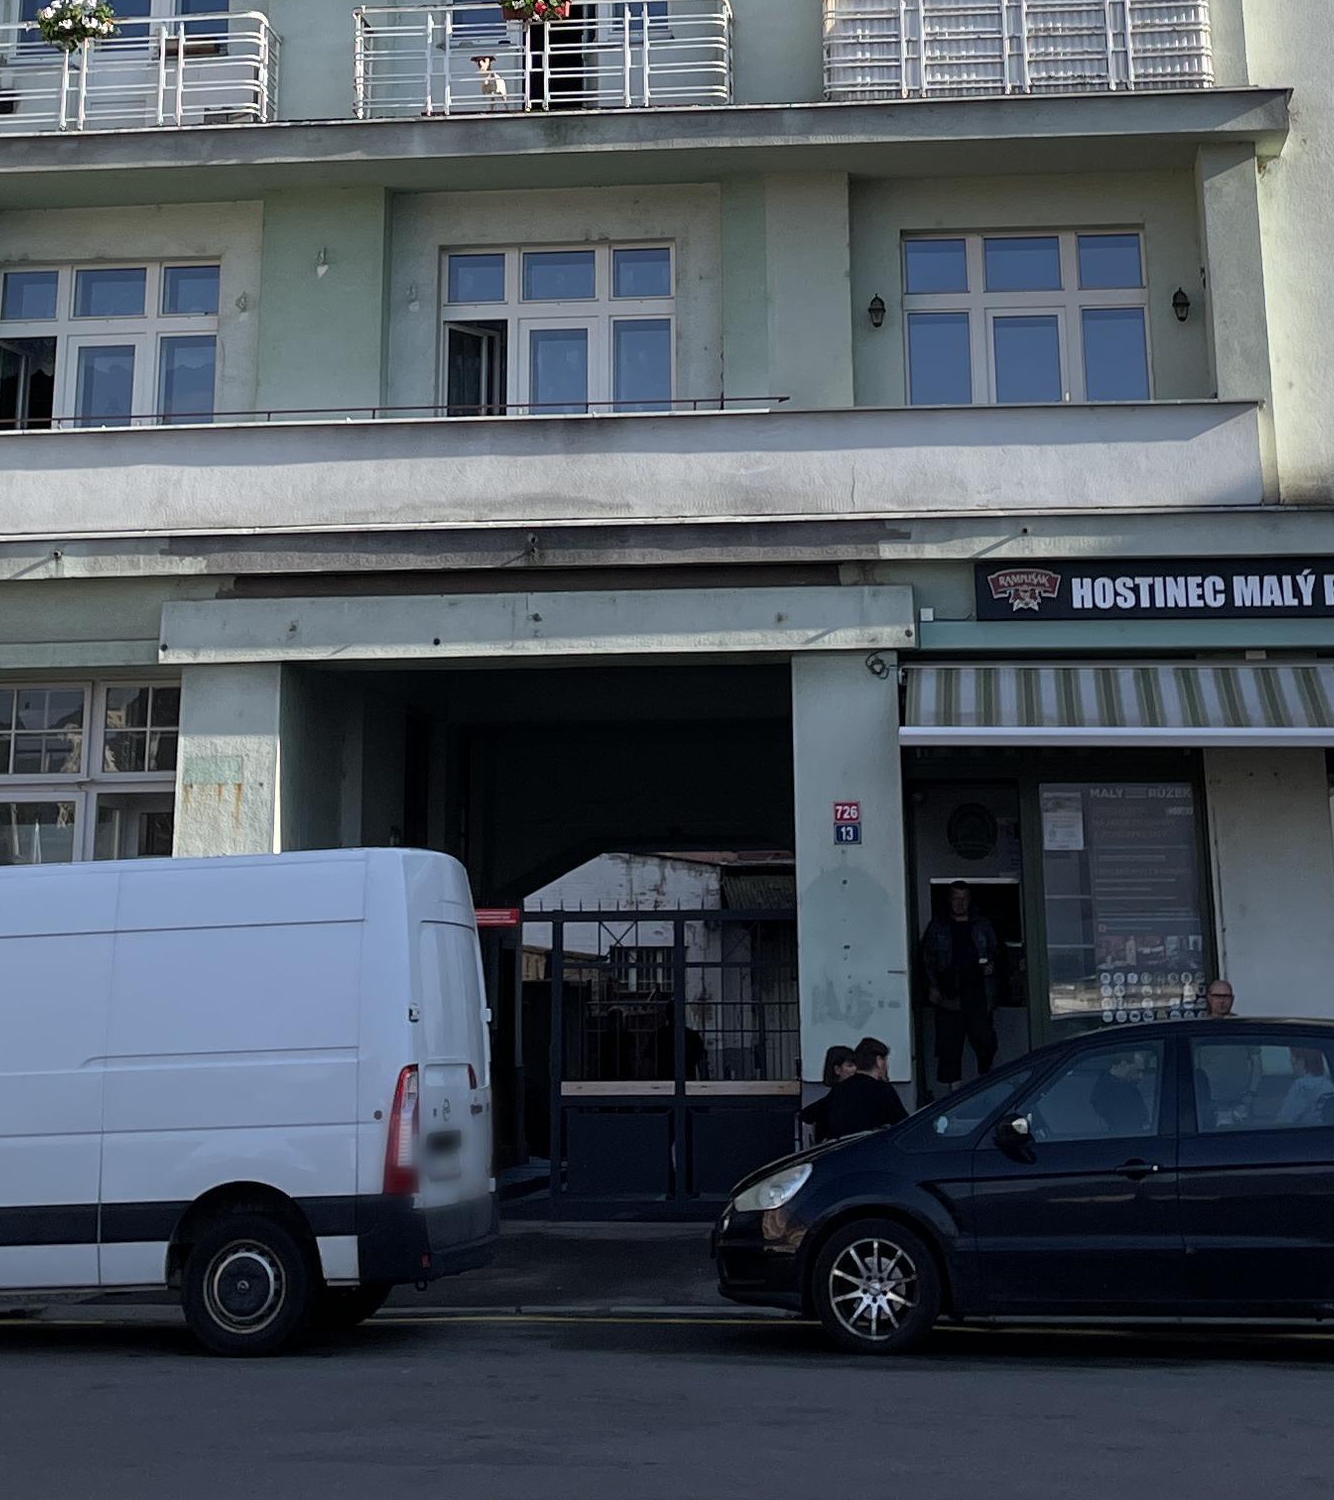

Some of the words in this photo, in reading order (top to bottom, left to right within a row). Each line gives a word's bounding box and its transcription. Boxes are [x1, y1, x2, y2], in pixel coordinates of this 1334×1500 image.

[1071, 575, 1226, 609] HOSTINEC
[1232, 568, 1316, 607] MALÝ
[835, 805, 858, 819] 726
[841, 826, 854, 841] 13
